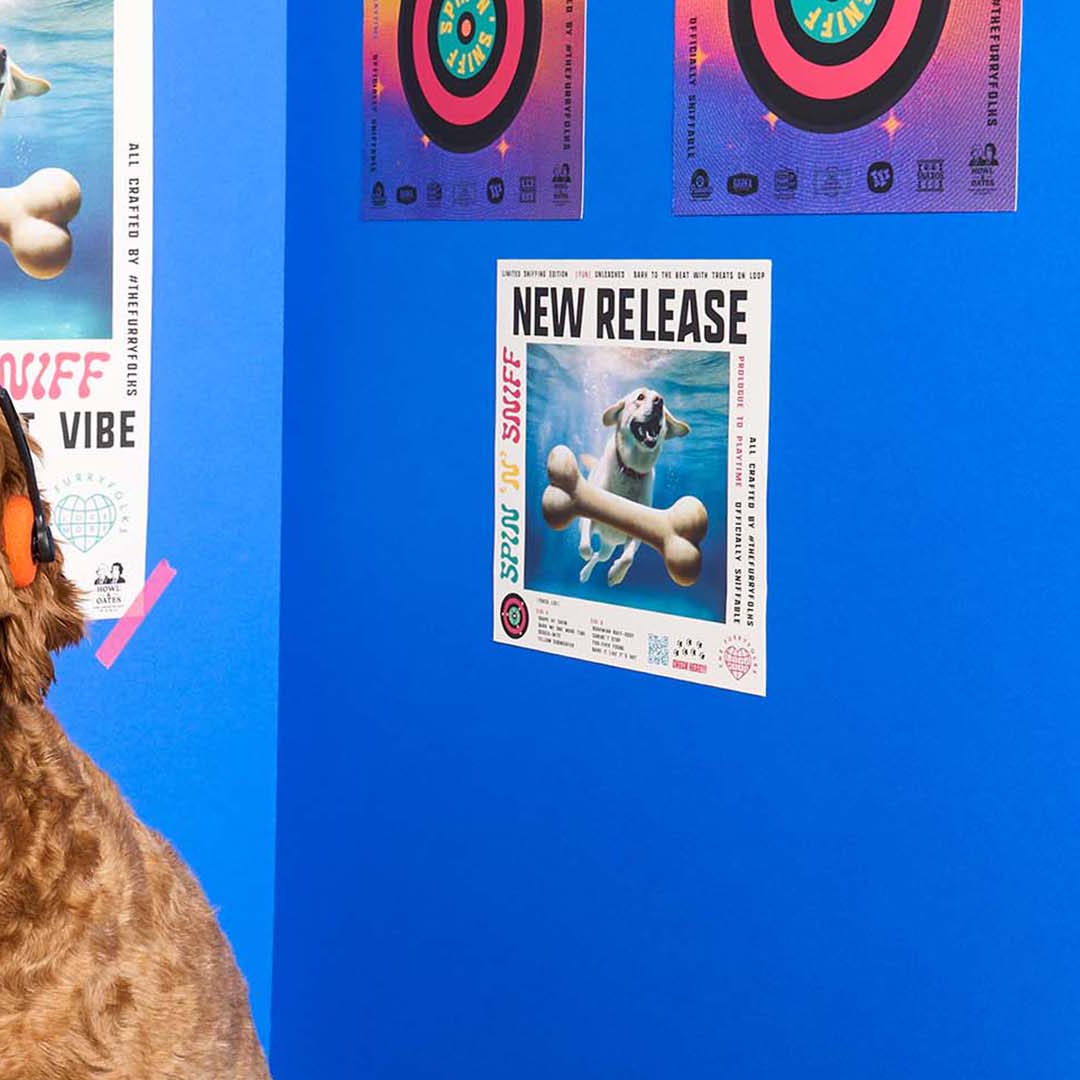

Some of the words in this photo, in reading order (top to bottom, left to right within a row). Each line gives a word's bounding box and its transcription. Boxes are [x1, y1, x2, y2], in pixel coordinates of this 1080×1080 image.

[804, 0, 872, 38] NIFF
[128, 142, 139, 168] ALL
[128, 178, 139, 240] CRAFTED
[128, 248, 139, 265] BY
[126, 275, 139, 397] #THEFURRYFOLKS
[513, 286, 586, 338] NEW
[596, 287, 748, 345] RELEASE
[502, 346, 521, 444] SNIFF
[736, 356, 745, 408] PROLOGUE
[60, 411, 136, 449] VIBE
[749, 436, 757, 455] ALL
[735, 435, 743, 487] PLAYTIME
[748, 463, 756, 509] CRAFTED
[500, 503, 520, 584] SPIN
[748, 516, 755, 529] BY
